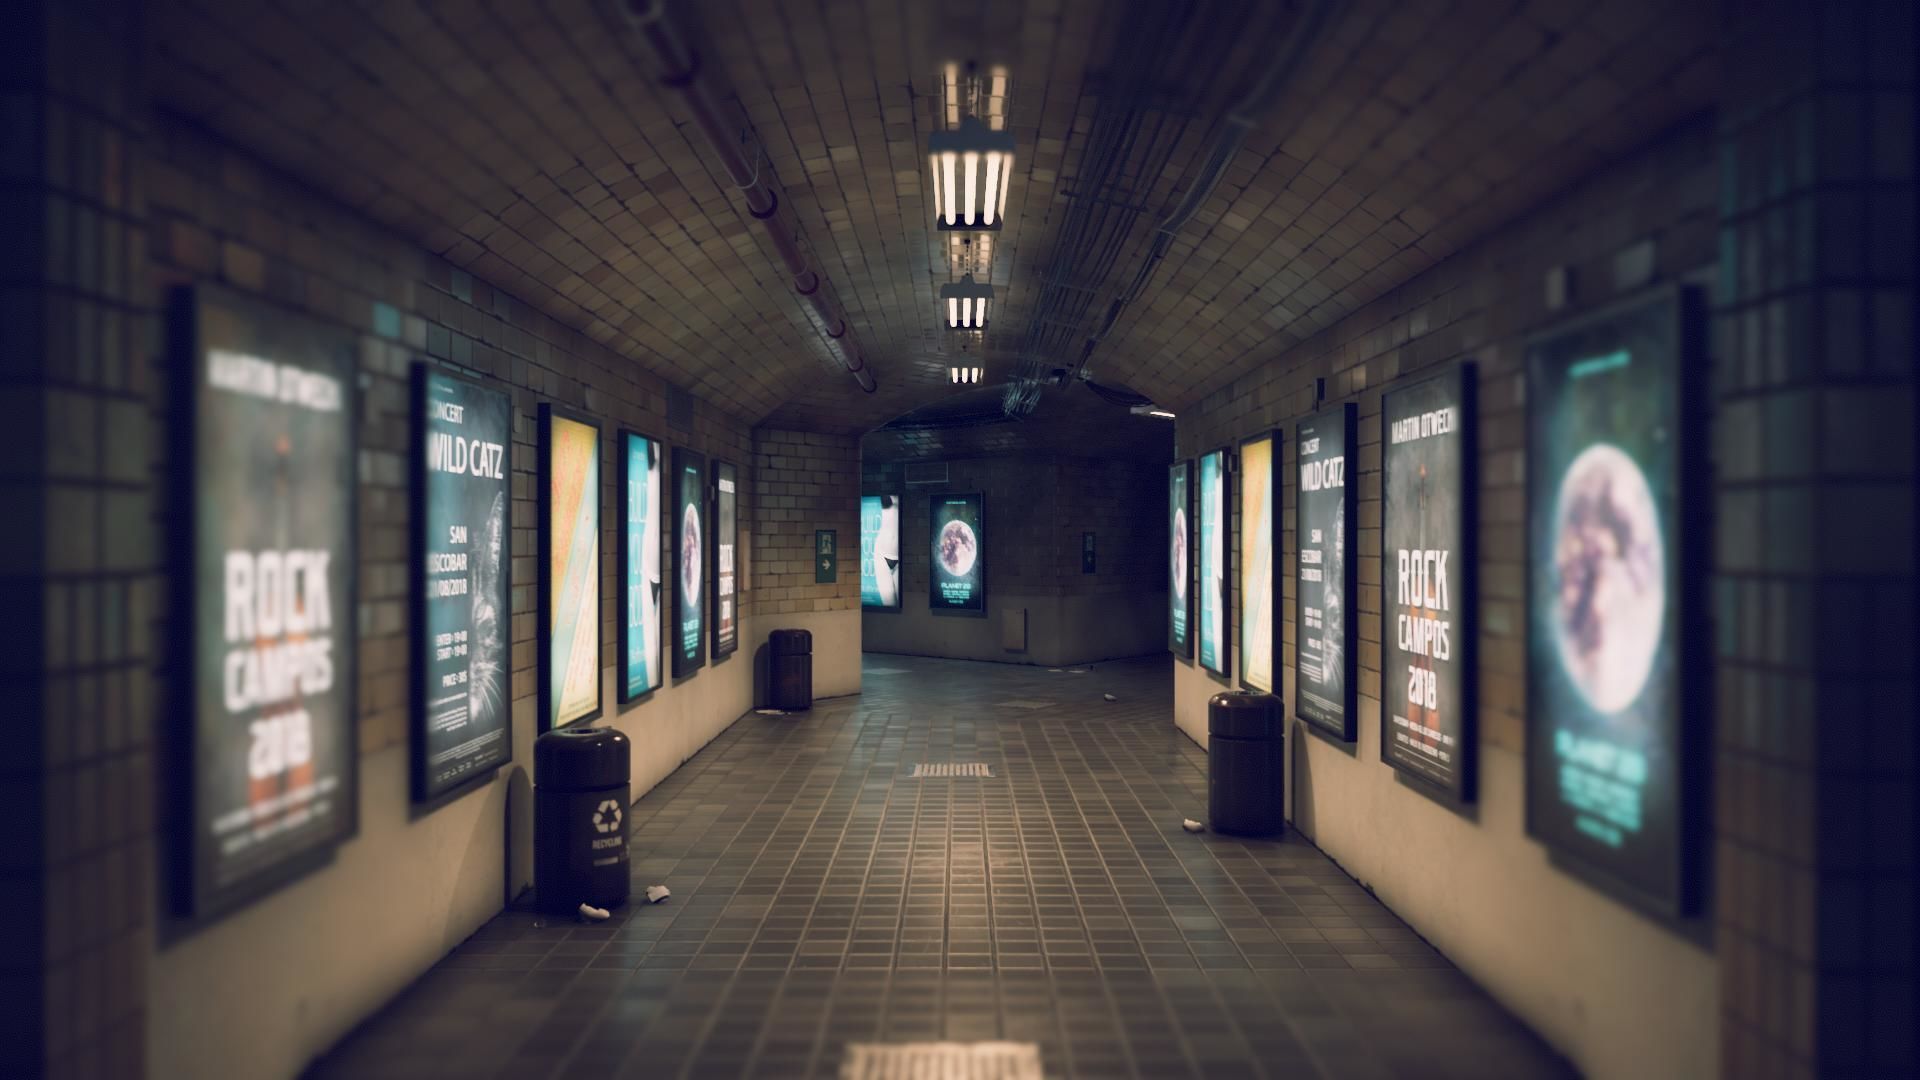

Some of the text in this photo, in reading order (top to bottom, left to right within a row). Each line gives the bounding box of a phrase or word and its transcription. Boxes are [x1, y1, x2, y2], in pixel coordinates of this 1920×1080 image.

[430, 399, 464, 425] ONCERT
[1391, 415, 1420, 445] MARTIN
[429, 432, 504, 480] WILD CATZ
[1301, 455, 1345, 492] WILD CATZ
[450, 525, 467, 544] SAN
[224, 549, 331, 642] ROCK
[1398, 549, 1449, 611] ROCK
[1398, 614, 1450, 661] CAMPOS
[224, 637, 334, 713] CAMPOS
[1408, 665, 1437, 711] 2018
[249, 708, 312, 780] 2018
